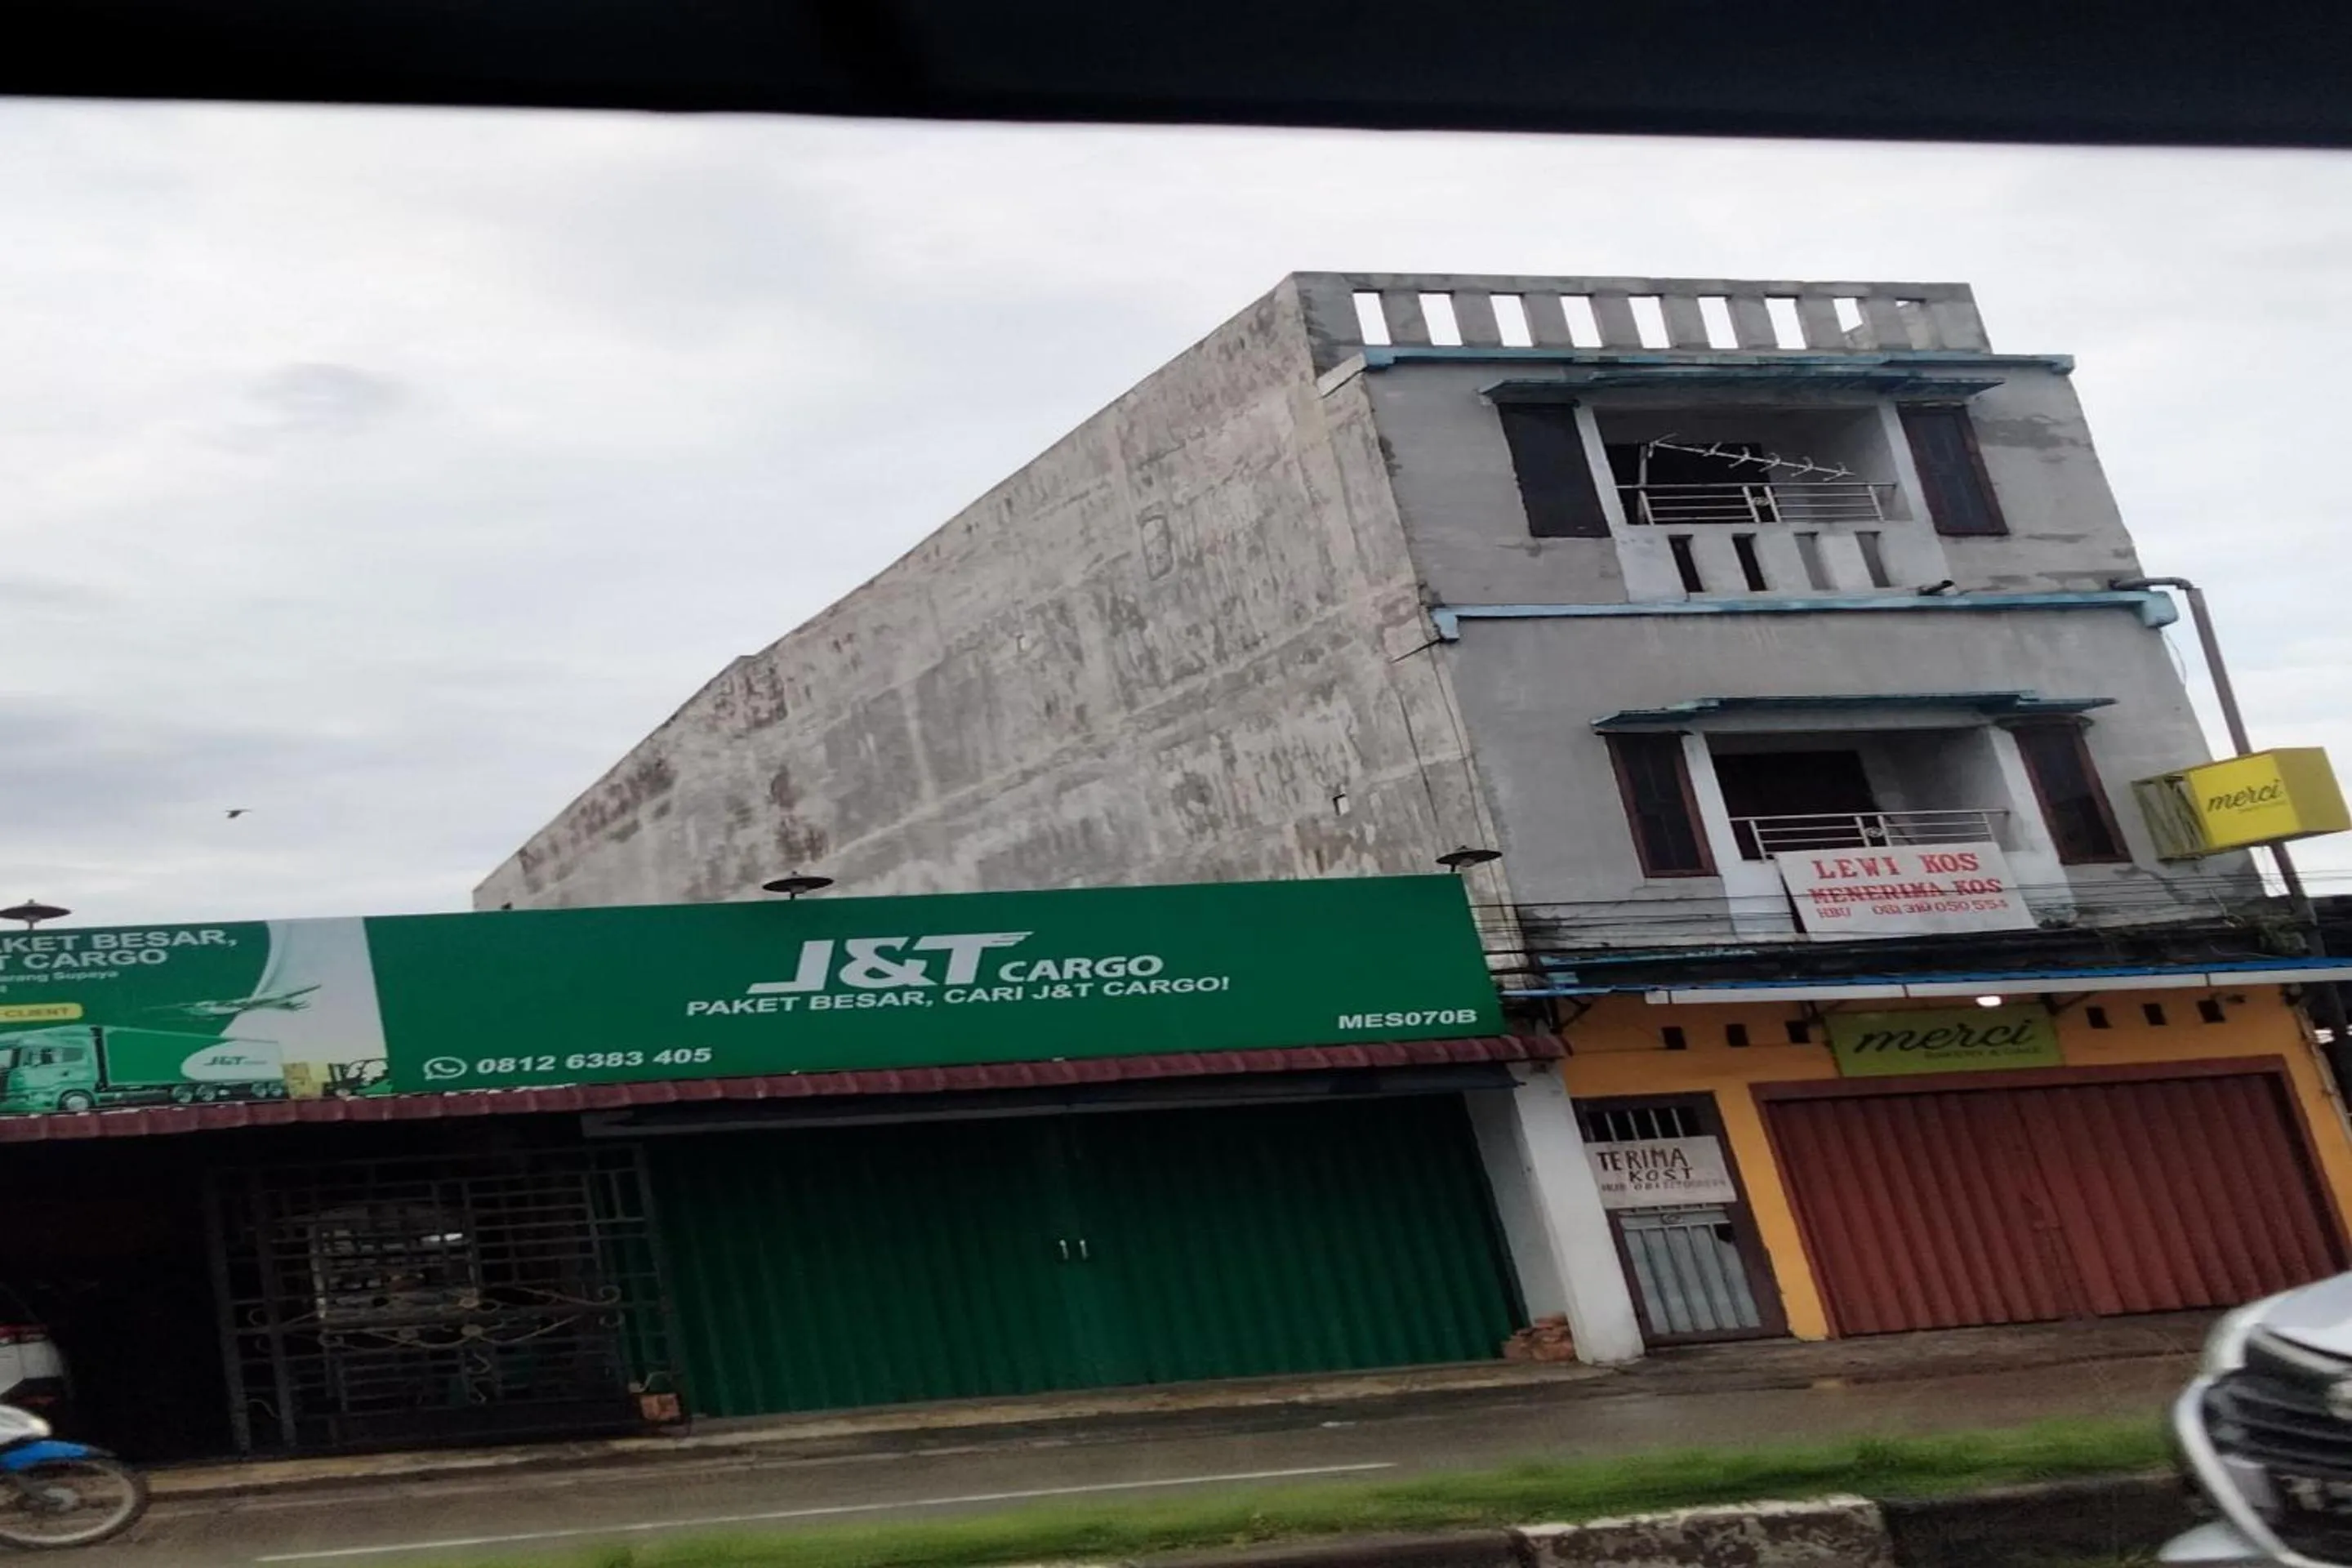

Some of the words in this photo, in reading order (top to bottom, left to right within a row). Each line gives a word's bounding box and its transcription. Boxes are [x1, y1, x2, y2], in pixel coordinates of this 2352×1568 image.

[2207, 779, 2283, 812] merci
[1812, 857, 1900, 879] LEWI
[1919, 853, 1980, 873] KOS
[1953, 878, 2003, 896] KOS
[0, 935, 81, 954] KET
[91, 929, 238, 949] BESAR,
[23, 948, 168, 969] CARGO
[746, 932, 1033, 994] J&T
[999, 955, 1164, 982] CARGO
[687, 997, 800, 1017] PAKET
[808, 990, 934, 1011] BESAR,
[944, 987, 1024, 1005] CARI
[1031, 982, 1094, 1000] J&T
[1102, 977, 1230, 996] CARGO!
[1338, 1009, 1477, 1029] MES070B
[1853, 1020, 2034, 1054] merci
[476, 1057, 555, 1074] 0812
[566, 1051, 644, 1069] 6383
[653, 1048, 713, 1065] 405
[1596, 1147, 1688, 1172] TERIMA
[1628, 1167, 1694, 1183] KOST
